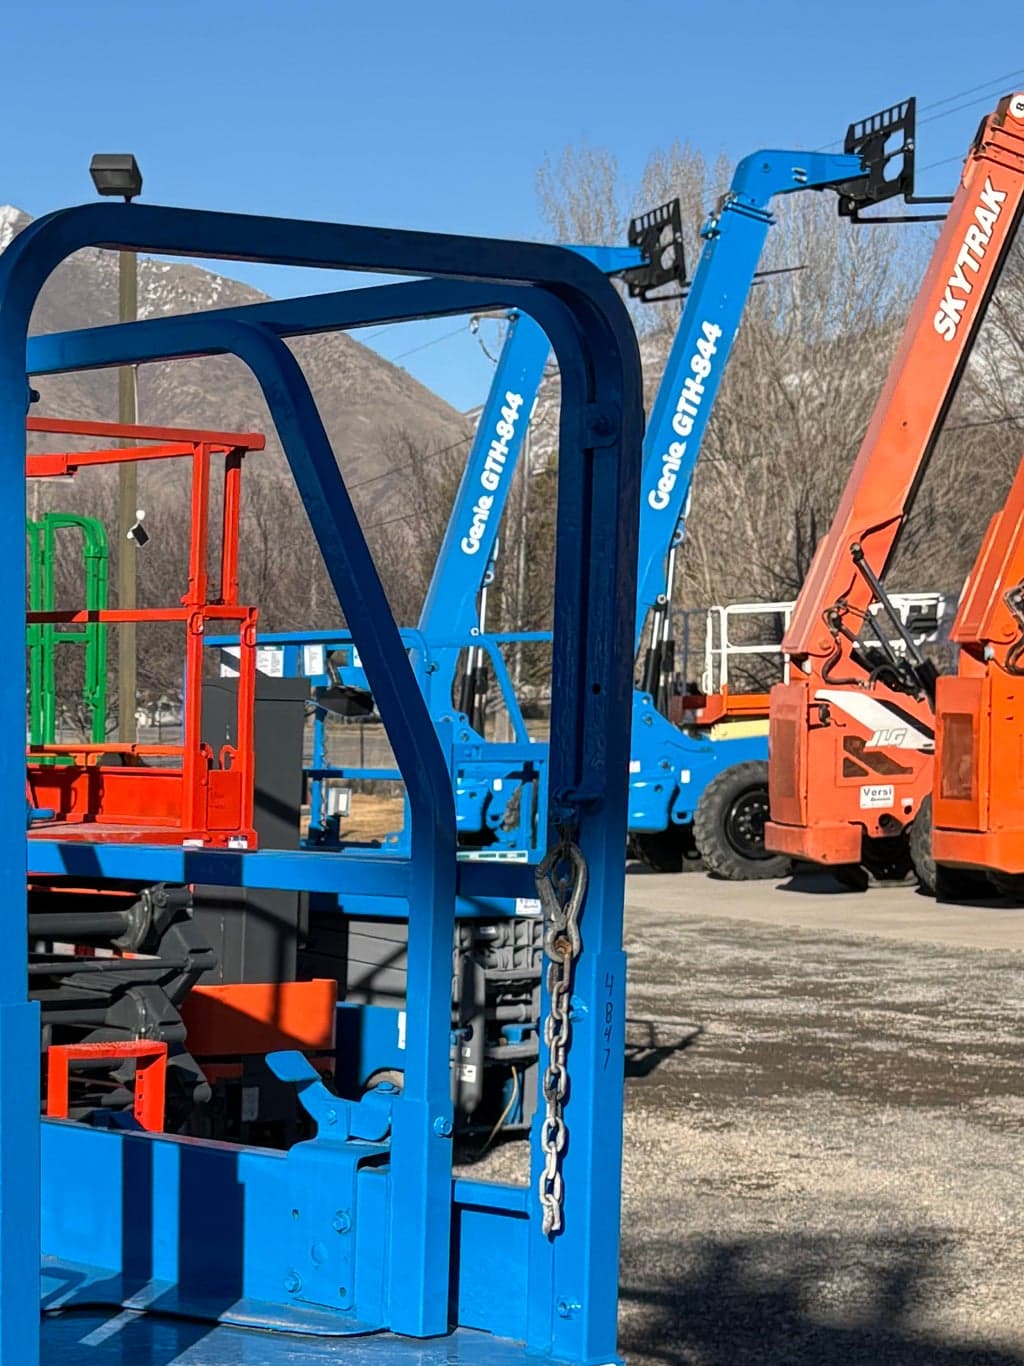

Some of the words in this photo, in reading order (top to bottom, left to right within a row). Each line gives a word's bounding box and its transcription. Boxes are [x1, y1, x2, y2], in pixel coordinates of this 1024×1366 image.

[933, 176, 1008, 342] SKYTRAK
[461, 495, 494, 555] Genie
[481, 391, 524, 491] GTH-844
[648, 440, 687, 510] Genie
[672, 320, 722, 437] GTH-844
